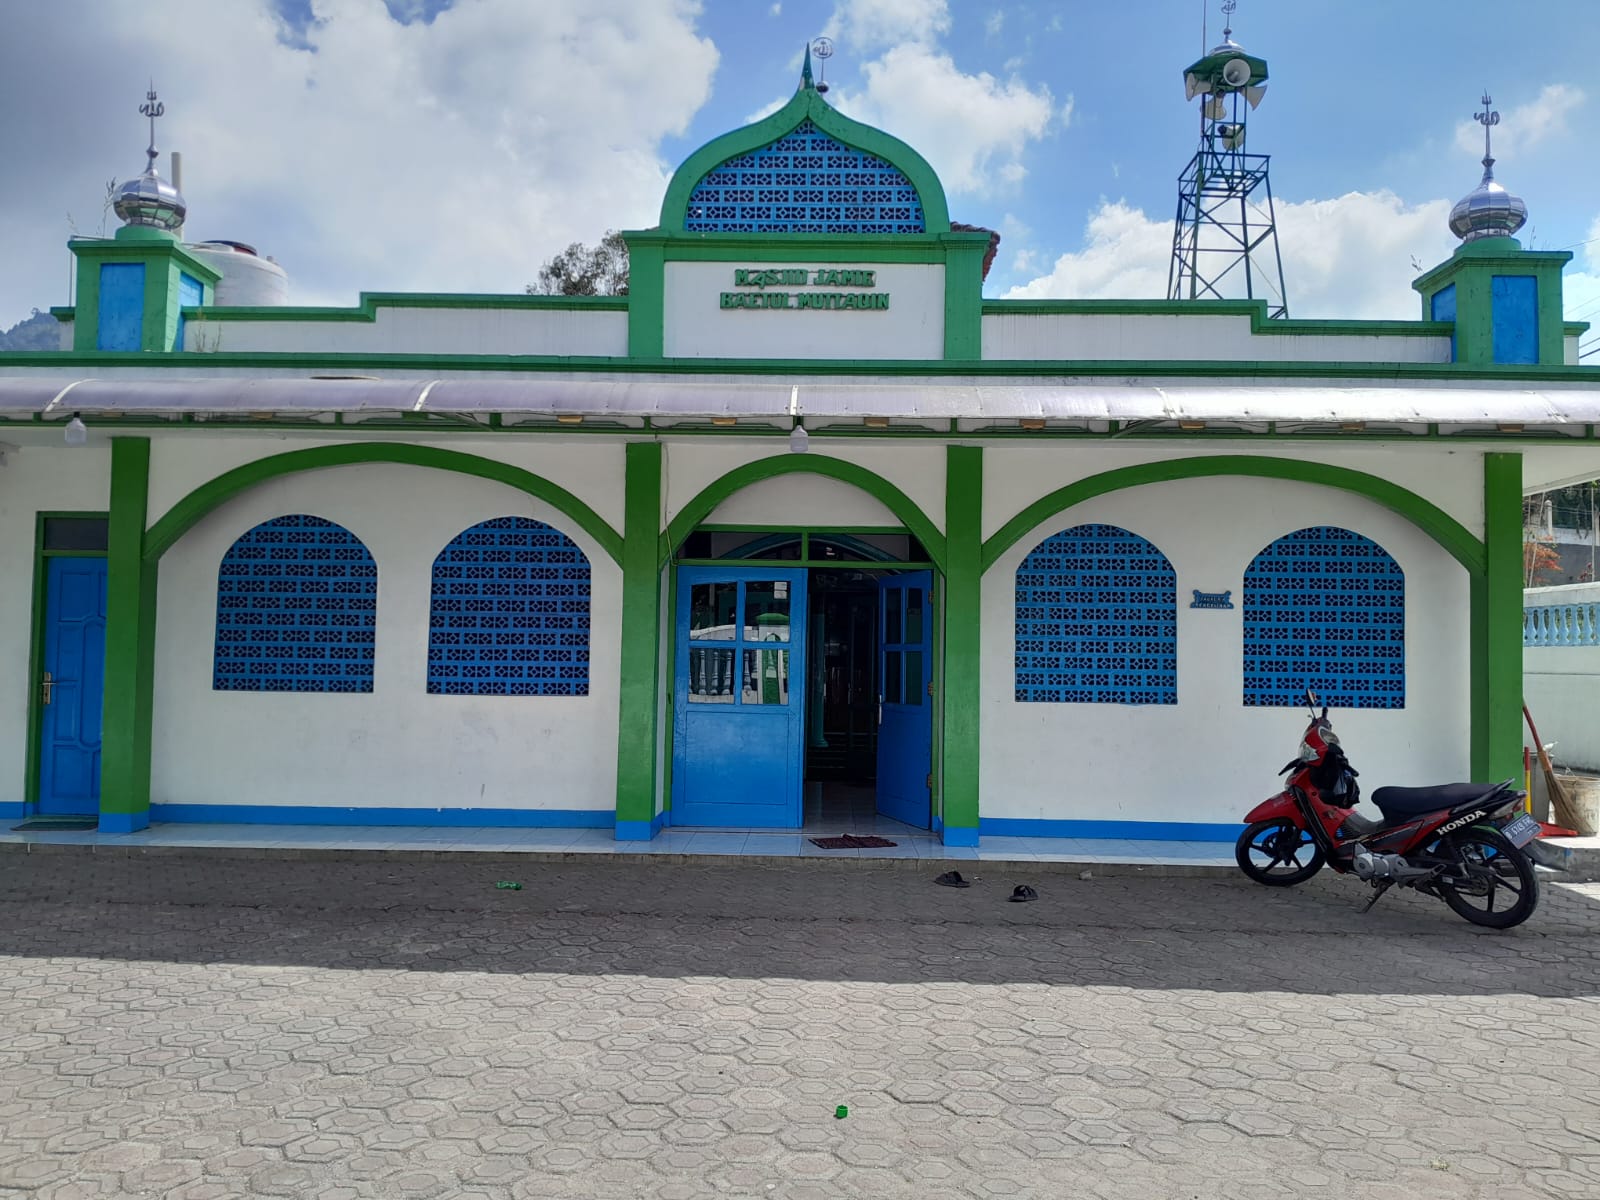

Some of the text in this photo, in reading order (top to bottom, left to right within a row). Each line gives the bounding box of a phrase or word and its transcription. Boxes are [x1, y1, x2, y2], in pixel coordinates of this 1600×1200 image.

[735, 269, 876, 289] MASJID JAMIE
[720, 292, 793, 310] BAETUL
[1436, 810, 1487, 835] HONDA
